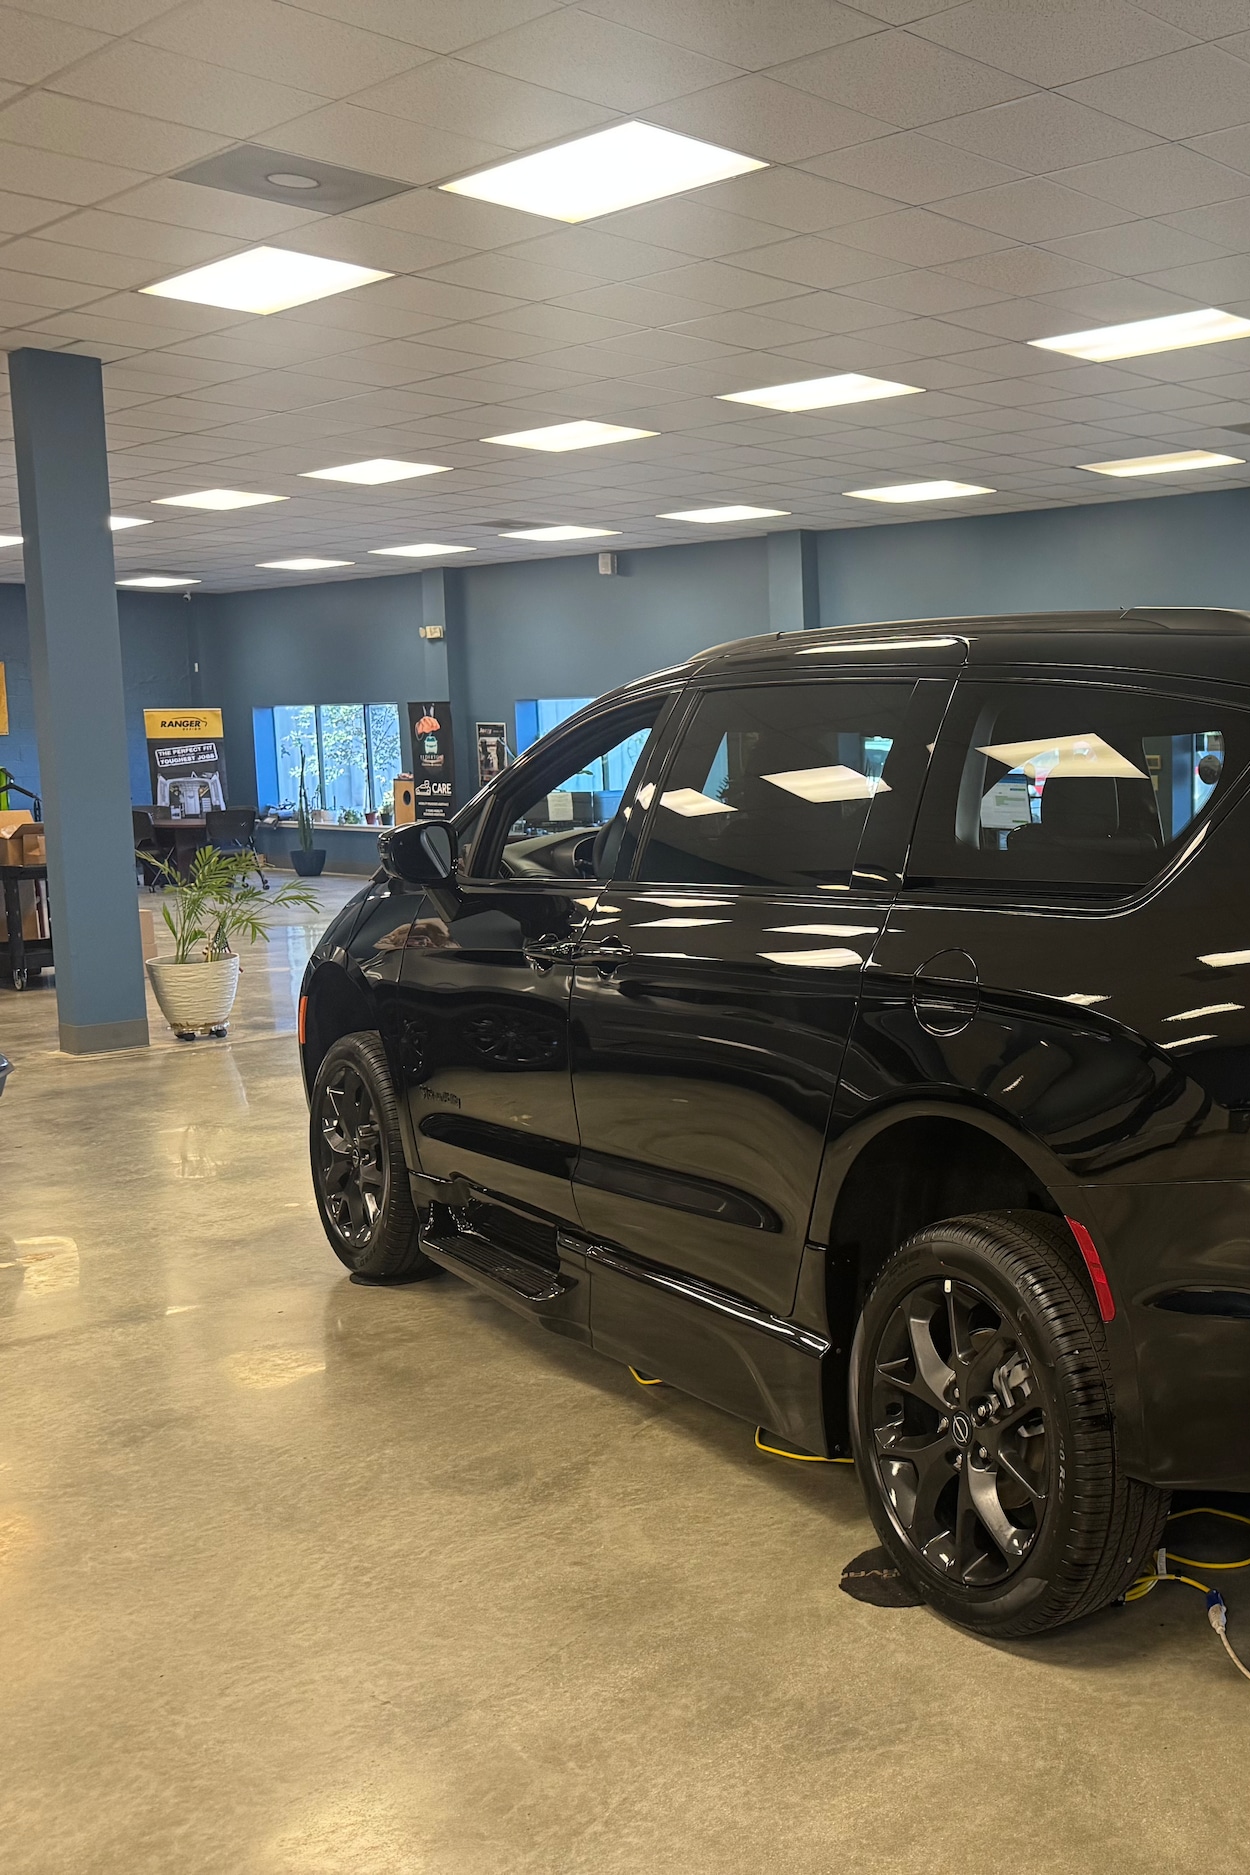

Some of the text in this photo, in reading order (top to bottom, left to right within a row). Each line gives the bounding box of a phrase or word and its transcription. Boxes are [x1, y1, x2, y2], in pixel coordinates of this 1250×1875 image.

[160, 720, 201, 728] RANGER
[172, 746, 202, 756] PERFECT
[160, 756, 196, 765] TOUGHEST
[432, 782, 452, 794] CARE
